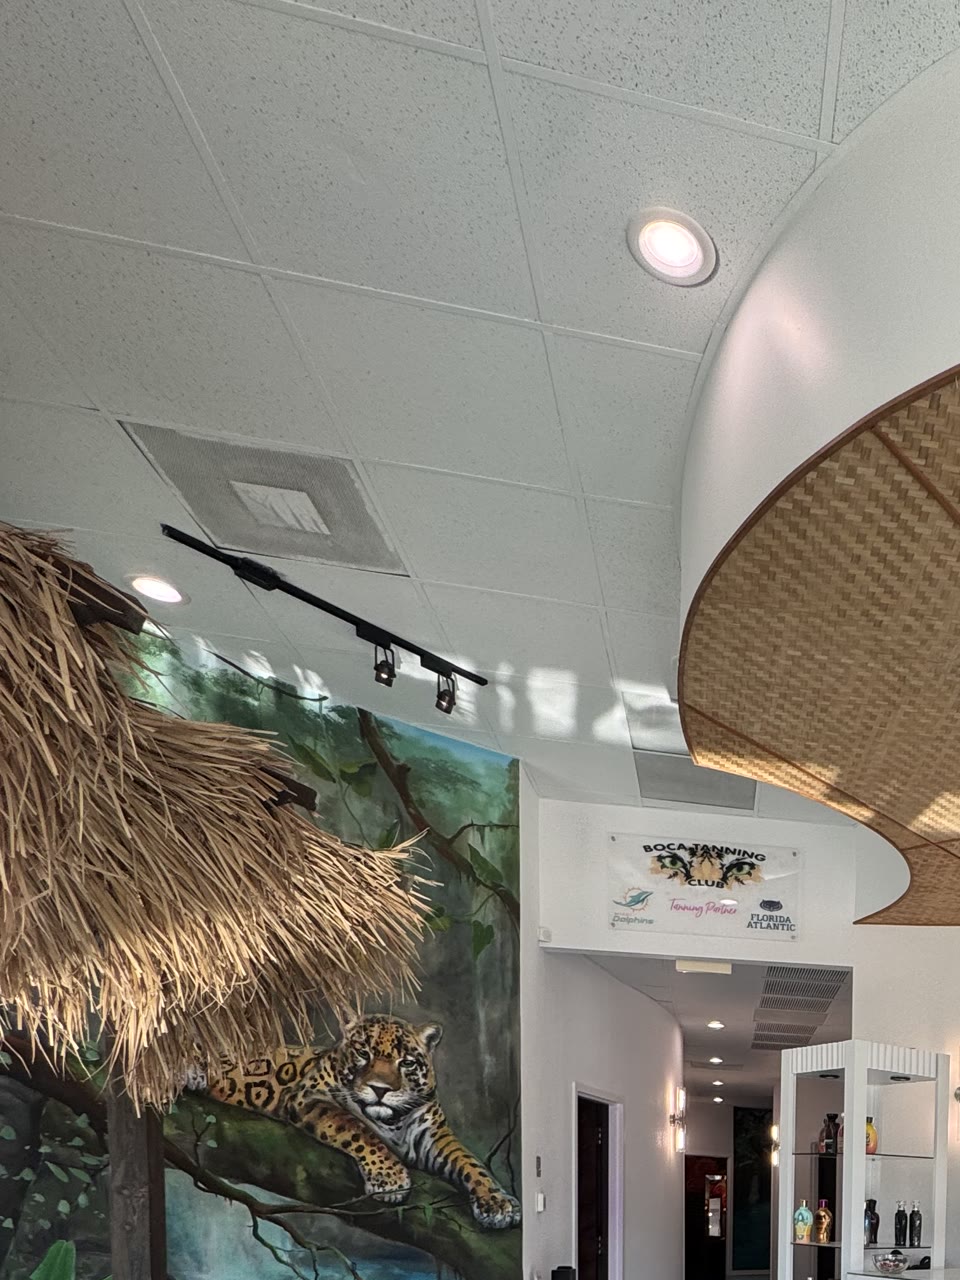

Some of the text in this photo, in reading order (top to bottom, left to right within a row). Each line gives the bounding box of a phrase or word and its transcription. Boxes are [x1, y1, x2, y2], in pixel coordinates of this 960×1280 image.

[642, 843, 767, 862] BOCA TANNING
[687, 878, 726, 889] CLUB
[669, 899, 738, 918] Tanning Partner
[612, 915, 655, 925] Dolphins
[750, 913, 792, 924] FLORIDA
[746, 920, 796, 932] ATLANTIC
